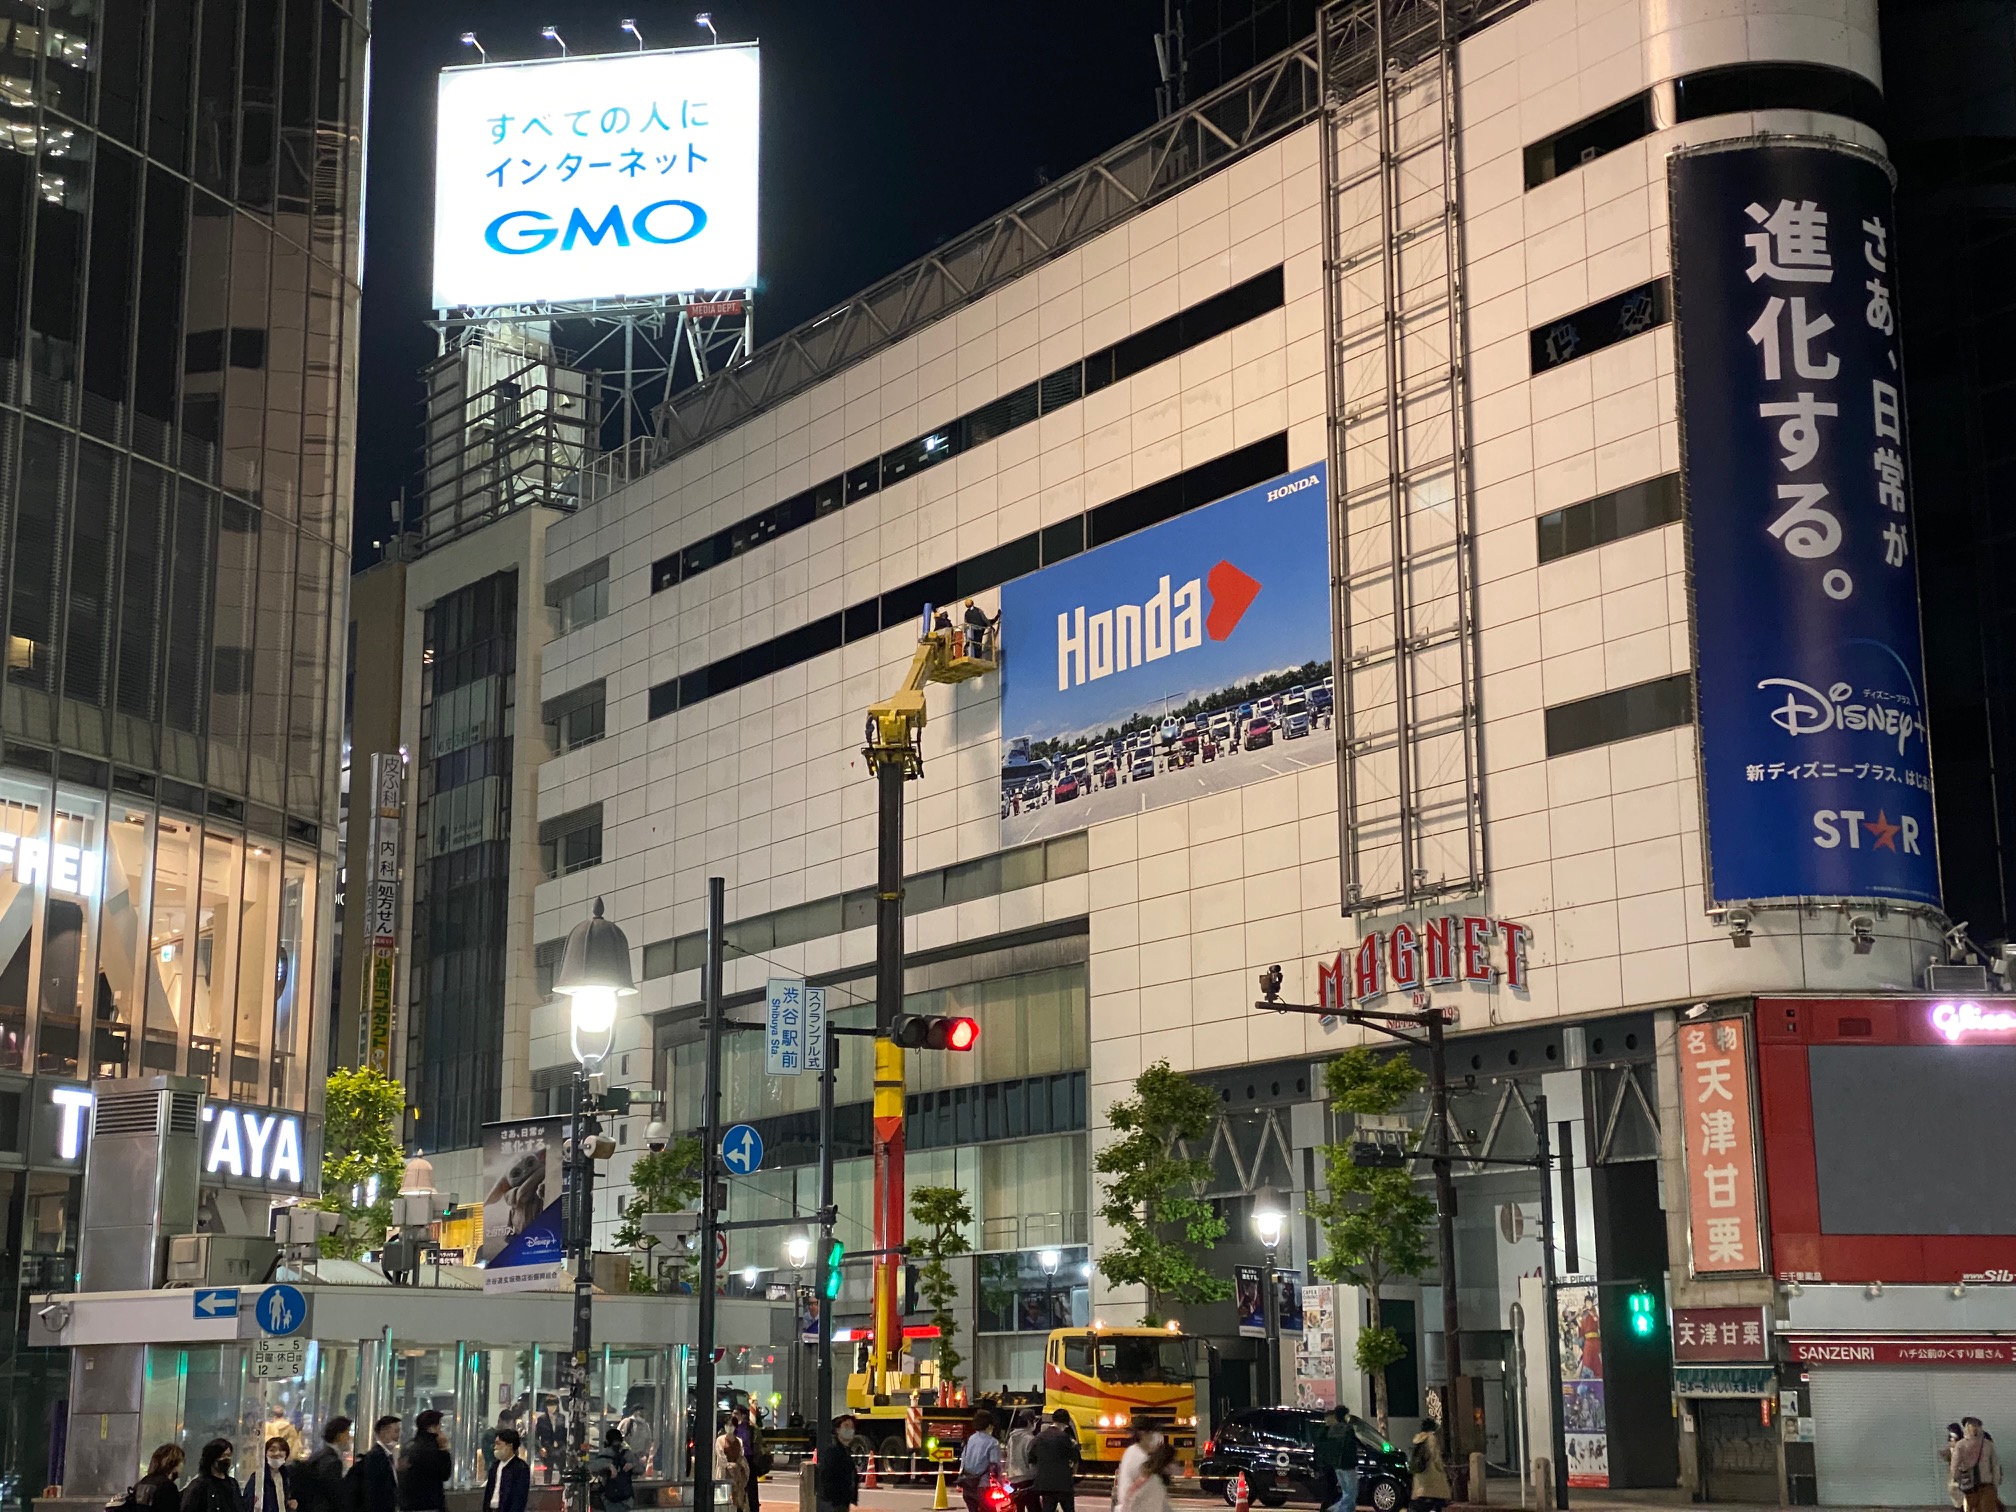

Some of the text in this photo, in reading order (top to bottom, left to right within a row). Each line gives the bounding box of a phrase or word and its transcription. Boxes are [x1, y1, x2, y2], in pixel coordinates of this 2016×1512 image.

[486, 99, 709, 145] すべての人に
[486, 142, 709, 188] インターネット
[484, 199, 708, 255] GMO
[692, 302, 738, 315] MEDIA DEPT.
[1743, 198, 1854, 601] 進化する。
[1862, 216, 1909, 568] さあ、日常が
[1266, 474, 1320, 503] HONDA
[1057, 574, 1202, 692] Honda
[1863, 688, 1911, 706] ディズニープラス
[383, 756, 399, 808] 皮ふ科
[380, 840, 395, 877] 内科
[376, 884, 394, 934] 処方せん
[1318, 915, 1528, 1027] MAGNET
[769, 998, 781, 1036] Shibuya
[781, 986, 800, 1069] 渋谷駅前
[808, 991, 822, 1068] スクランブル式
[1686, 1026, 1738, 1055] 名物
[52, 1088, 303, 1183] TAYA
[1695, 1058, 1745, 1264] 天津甘栗
[258, 1340, 269, 1351] 15
[293, 1340, 300, 1350] 5
[1678, 1321, 1761, 1346] 天津甘栗
[1798, 1346, 1875, 1360] SANZENRI
[1899, 1348, 2004, 1359] ハチ公前のくすり屋さん
[258, 1365, 269, 1376] 12
[292, 1363, 299, 1374] 5
